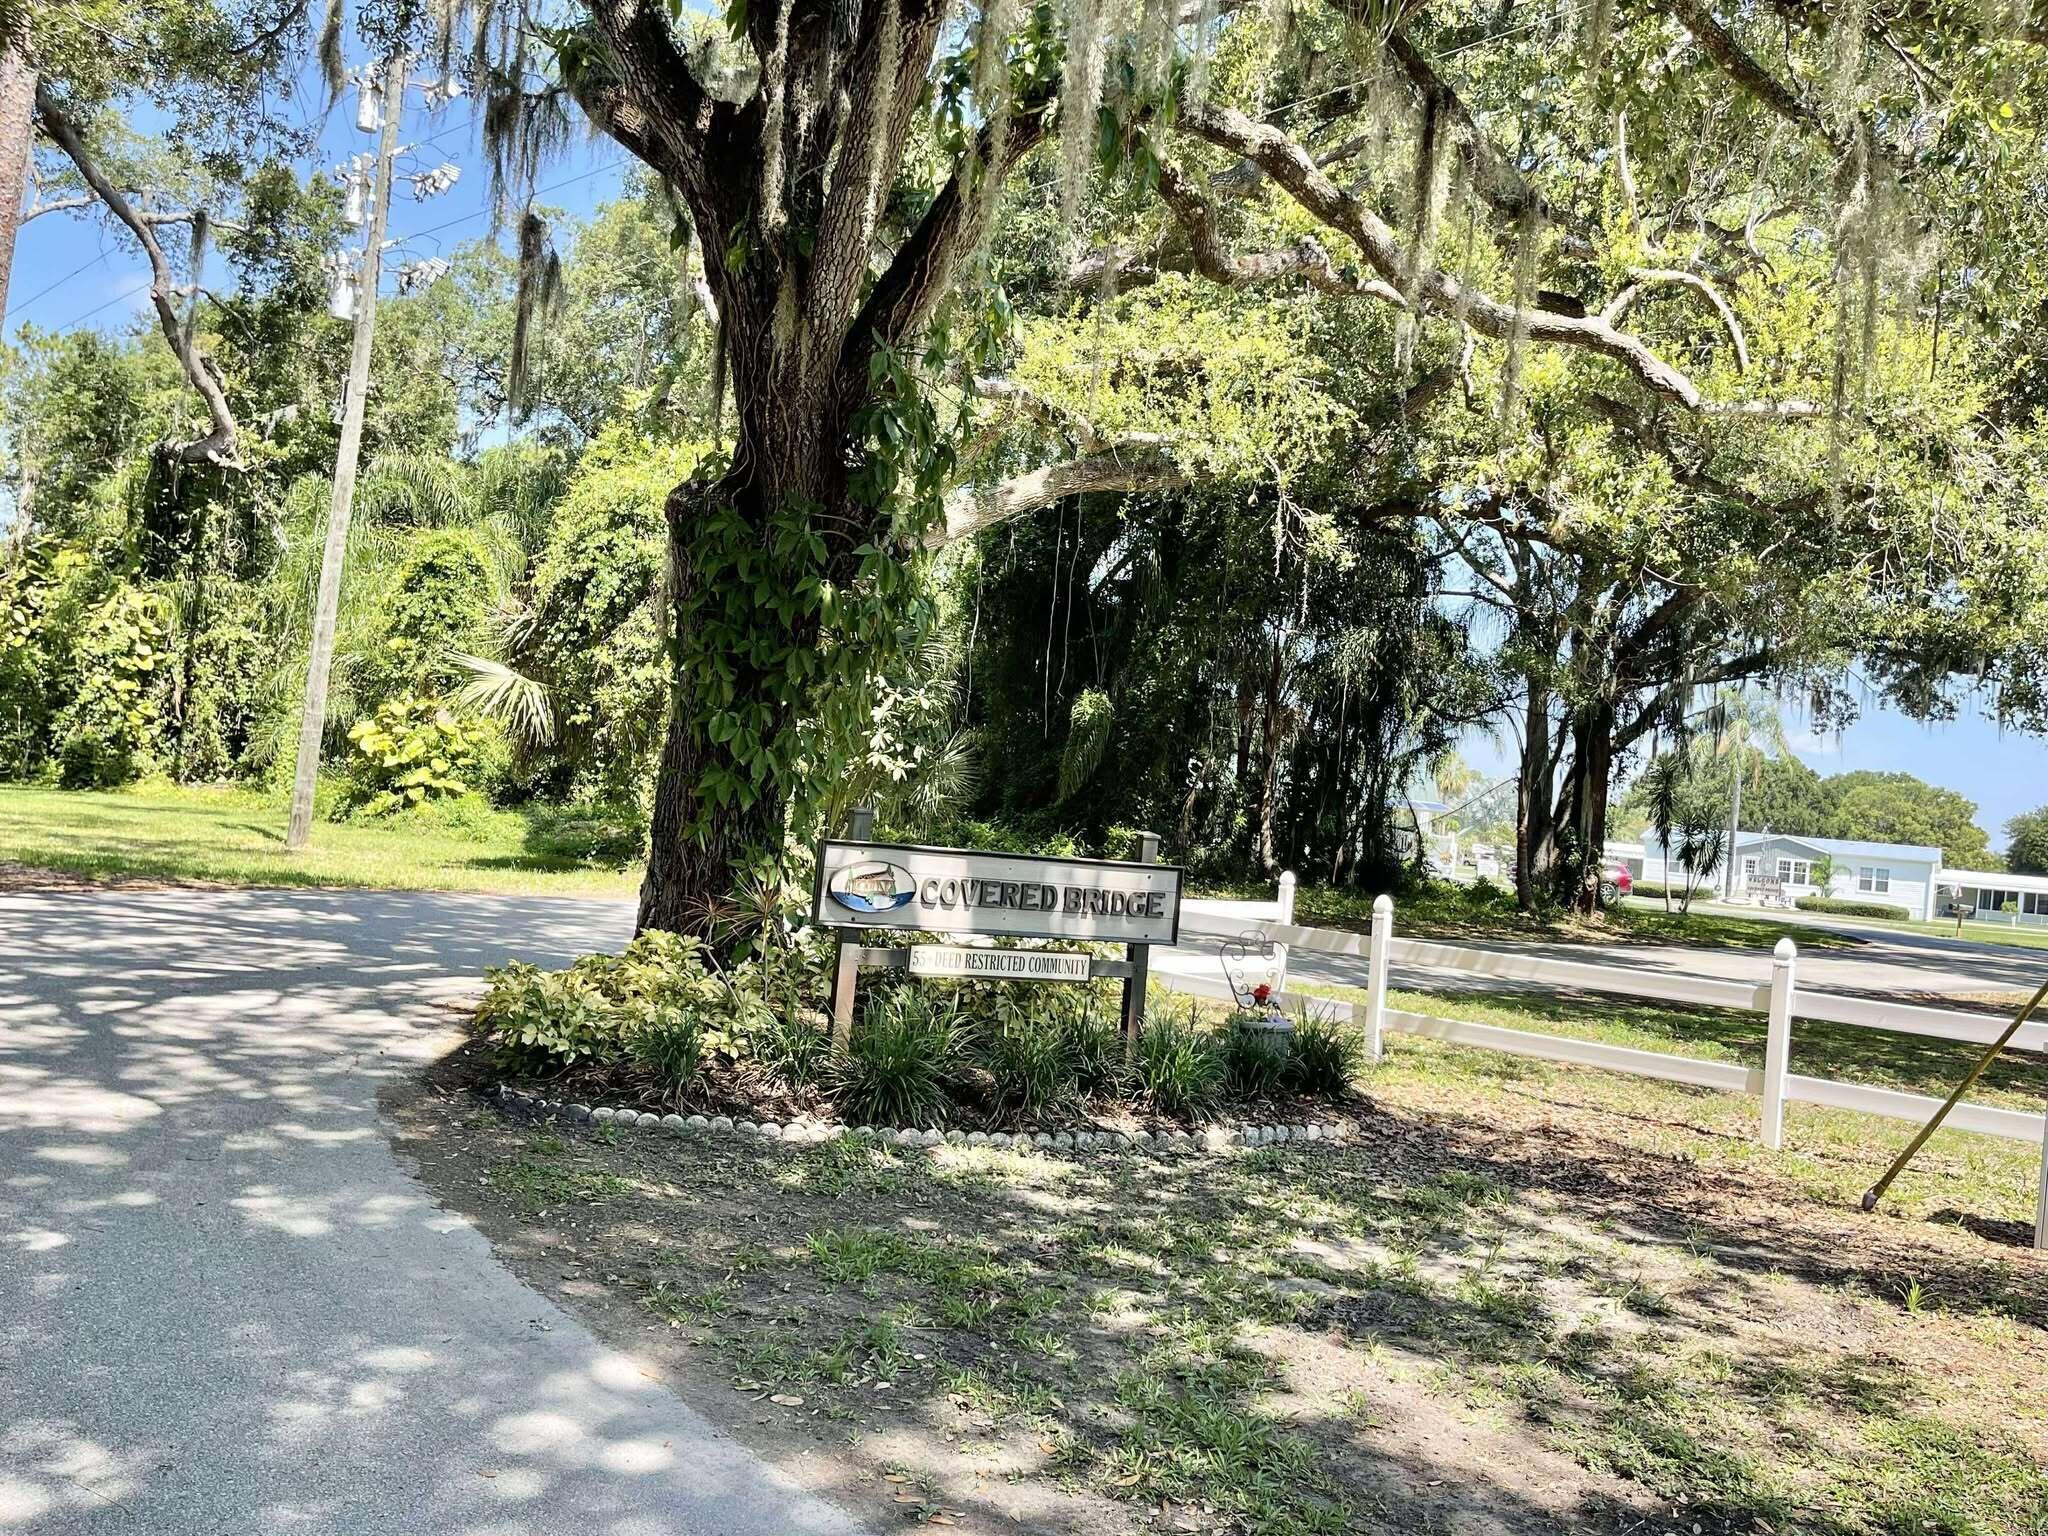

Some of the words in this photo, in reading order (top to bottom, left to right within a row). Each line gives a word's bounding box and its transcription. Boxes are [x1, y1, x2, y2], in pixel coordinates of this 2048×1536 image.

[920, 878, 1058, 911] COVERED
[1062, 886, 1167, 918] BRIDGE
[934, 951, 962, 969] DEED
[964, 953, 1026, 972] RESTRICTED
[1028, 956, 1087, 975] COMMUNITY
